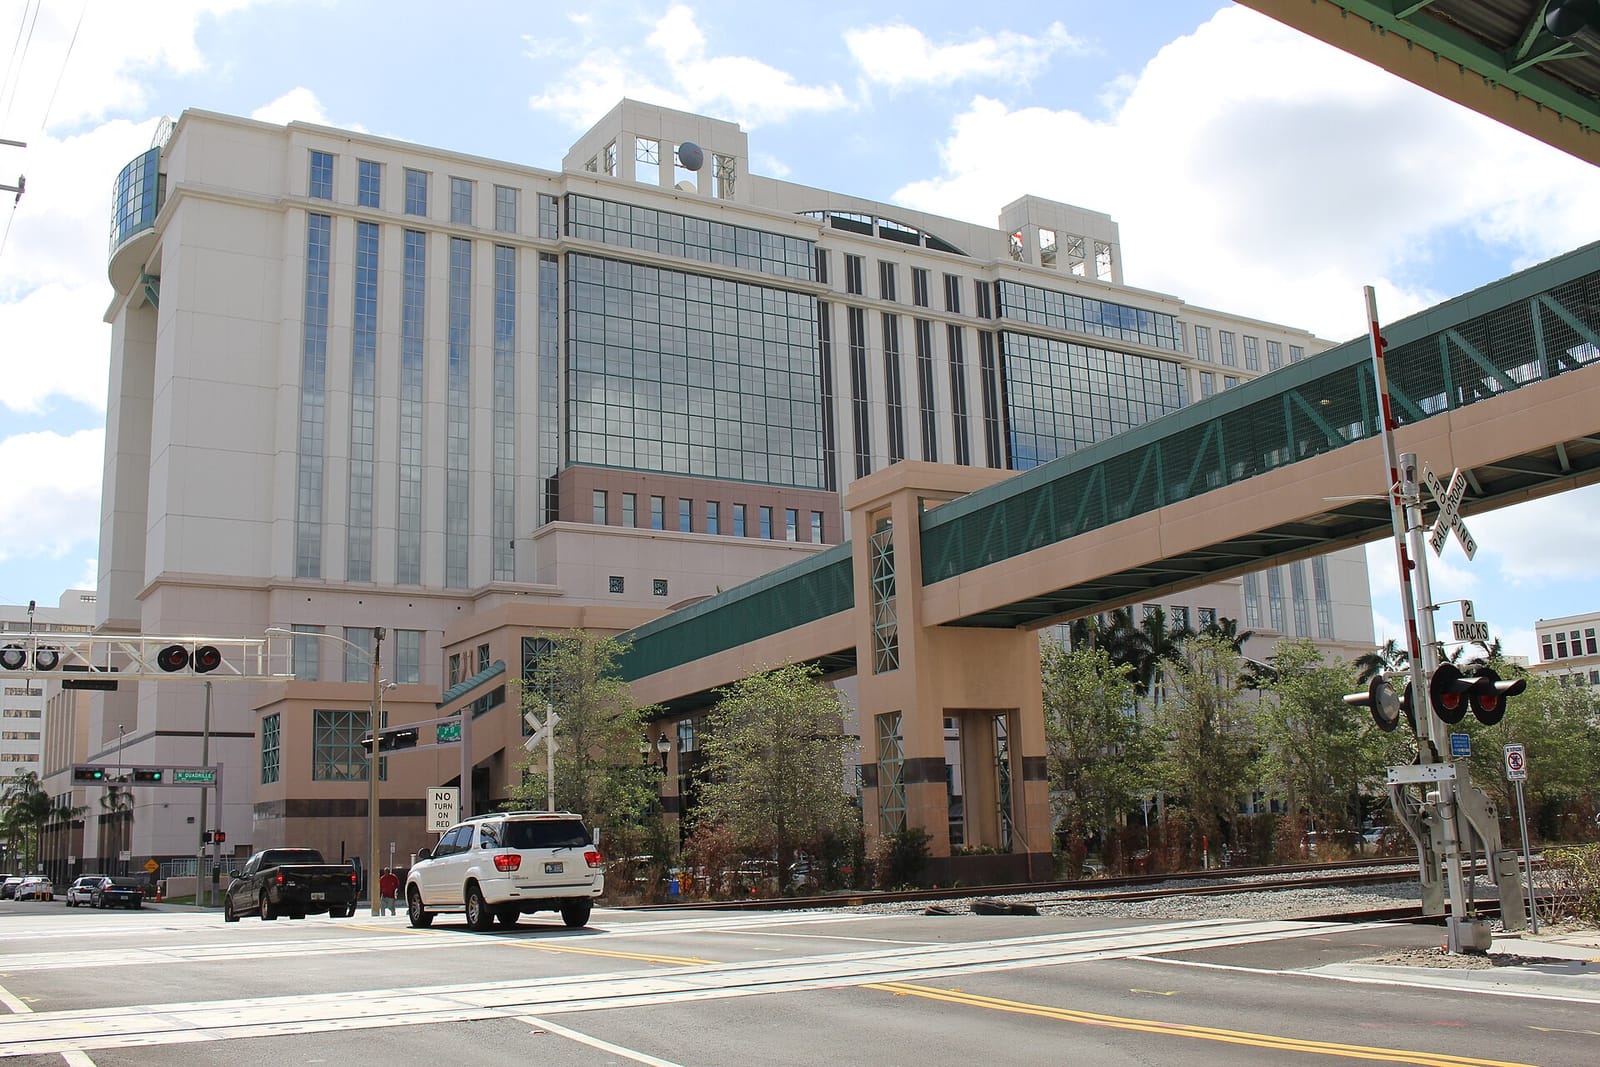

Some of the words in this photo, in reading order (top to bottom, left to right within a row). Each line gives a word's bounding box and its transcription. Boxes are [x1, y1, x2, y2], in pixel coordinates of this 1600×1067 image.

[1427, 471, 1474, 552] CROSSING
[1464, 600, 1473, 617] 2
[1454, 623, 1488, 640] TRACKS
[435, 792, 451, 801] NO
[434, 802, 453, 810] TURN
[436, 820, 450, 828] RED
